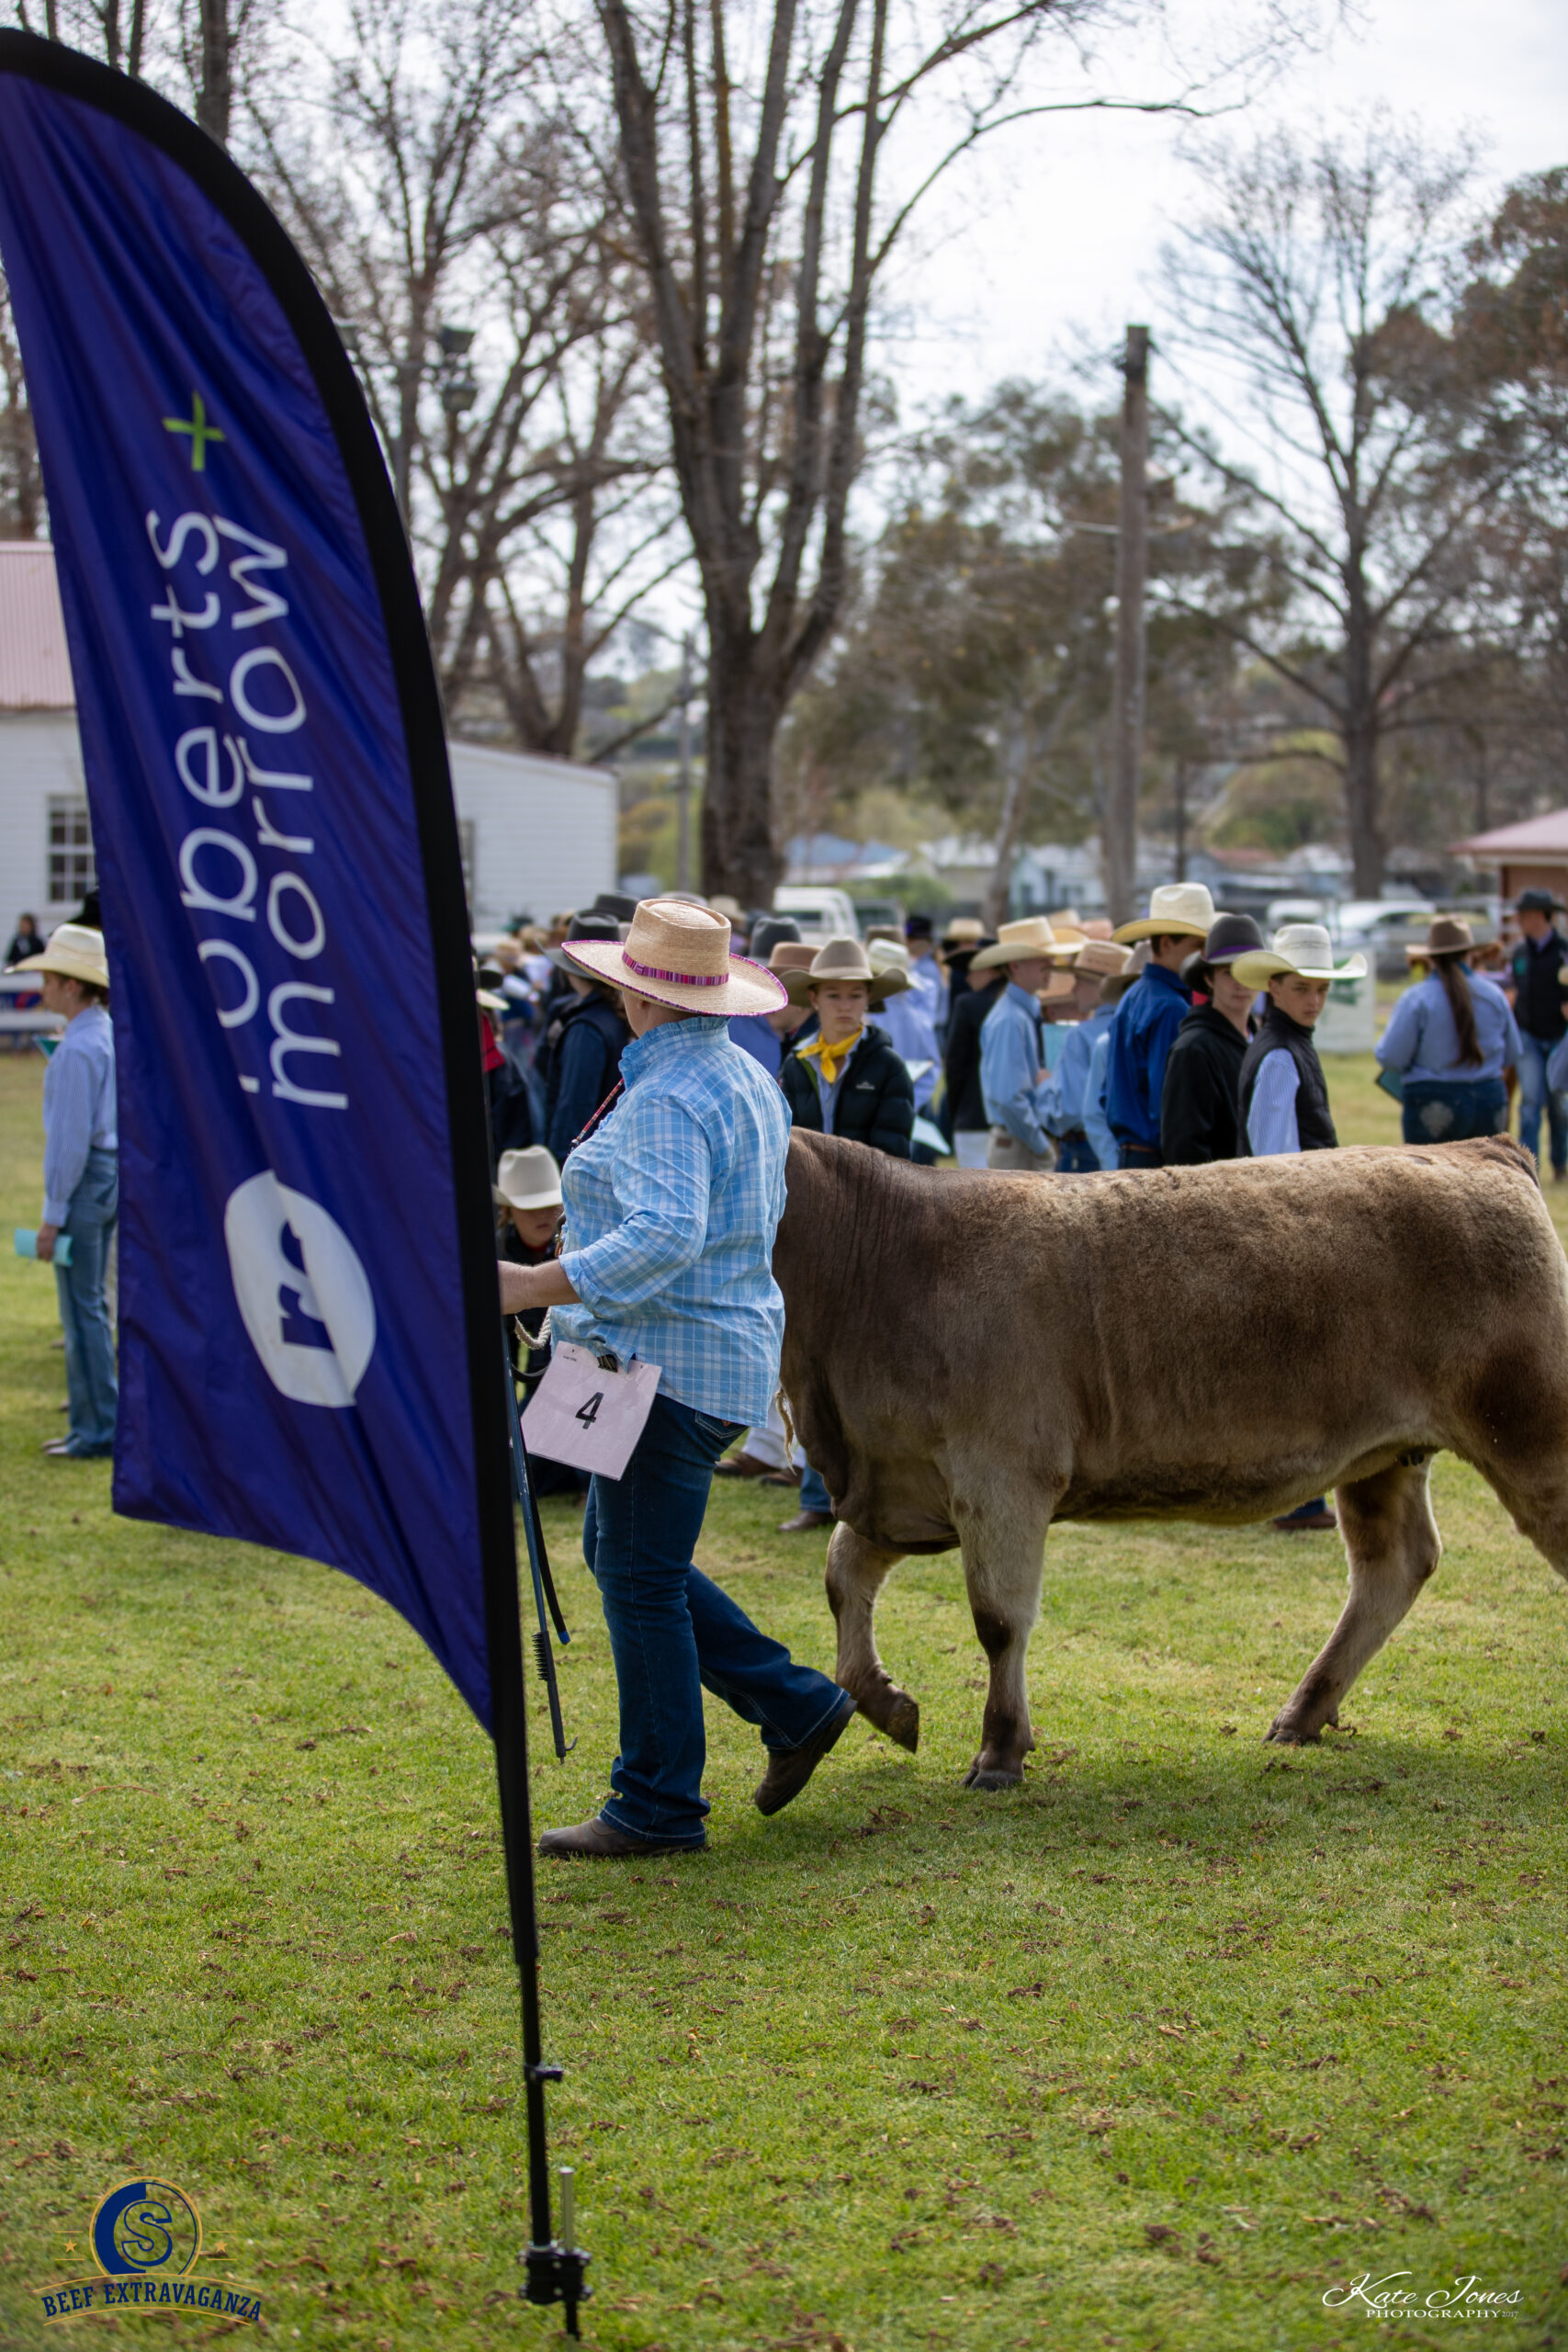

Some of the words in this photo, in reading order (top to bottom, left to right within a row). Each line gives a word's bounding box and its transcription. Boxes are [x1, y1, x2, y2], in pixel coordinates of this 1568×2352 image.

[145, 509, 260, 1093] oberts
[213, 514, 348, 1111] morrow
[575, 1392, 604, 1430] 4
